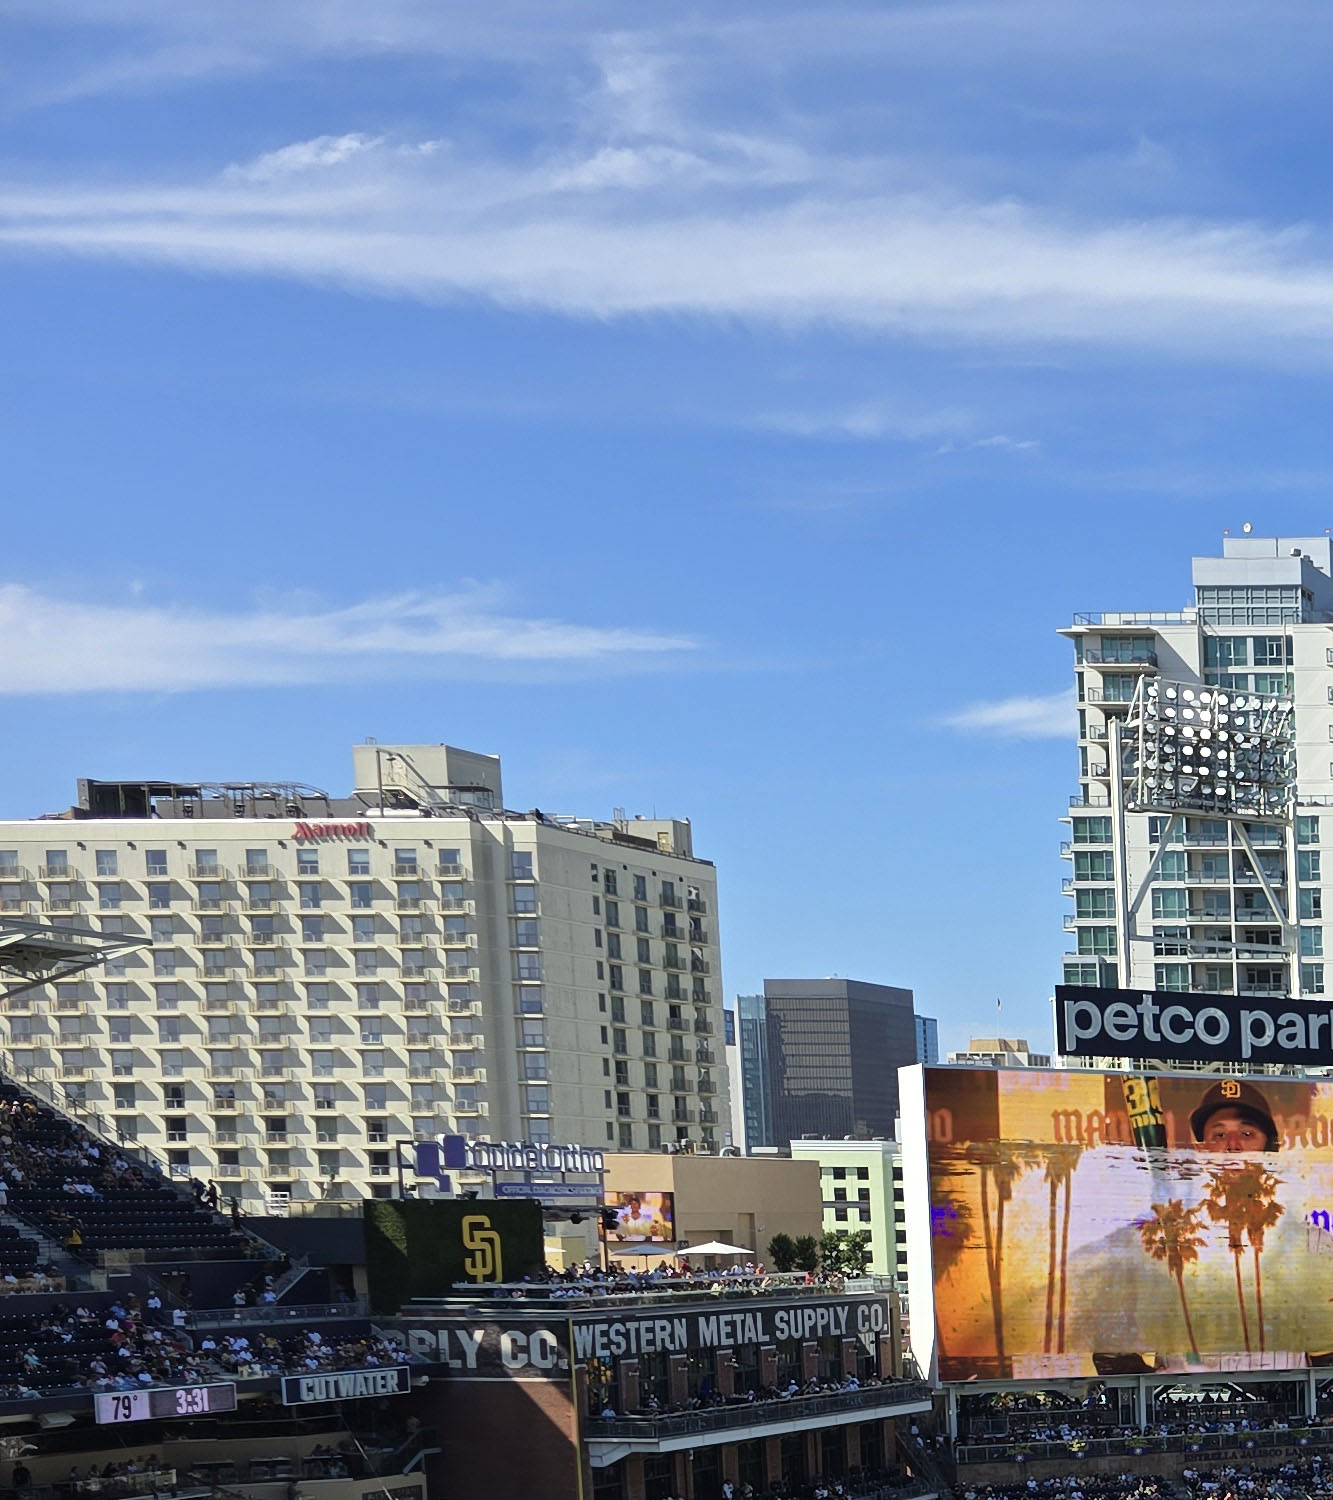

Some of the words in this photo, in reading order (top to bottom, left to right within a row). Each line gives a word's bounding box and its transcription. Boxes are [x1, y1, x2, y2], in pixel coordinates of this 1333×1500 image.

[291, 821, 370, 840] Marriott
[1064, 993, 1230, 1051] petco
[573, 1317, 688, 1359] WESTERN
[699, 1311, 770, 1348] METAL
[775, 1304, 850, 1341] SUPPLY
[857, 1303, 888, 1332] CO.
[500, 1329, 568, 1370] CO.
[176, 1387, 210, 1414] 3:31
[299, 1370, 399, 1401] CUTWATER
[111, 1393, 138, 1421] 79°
